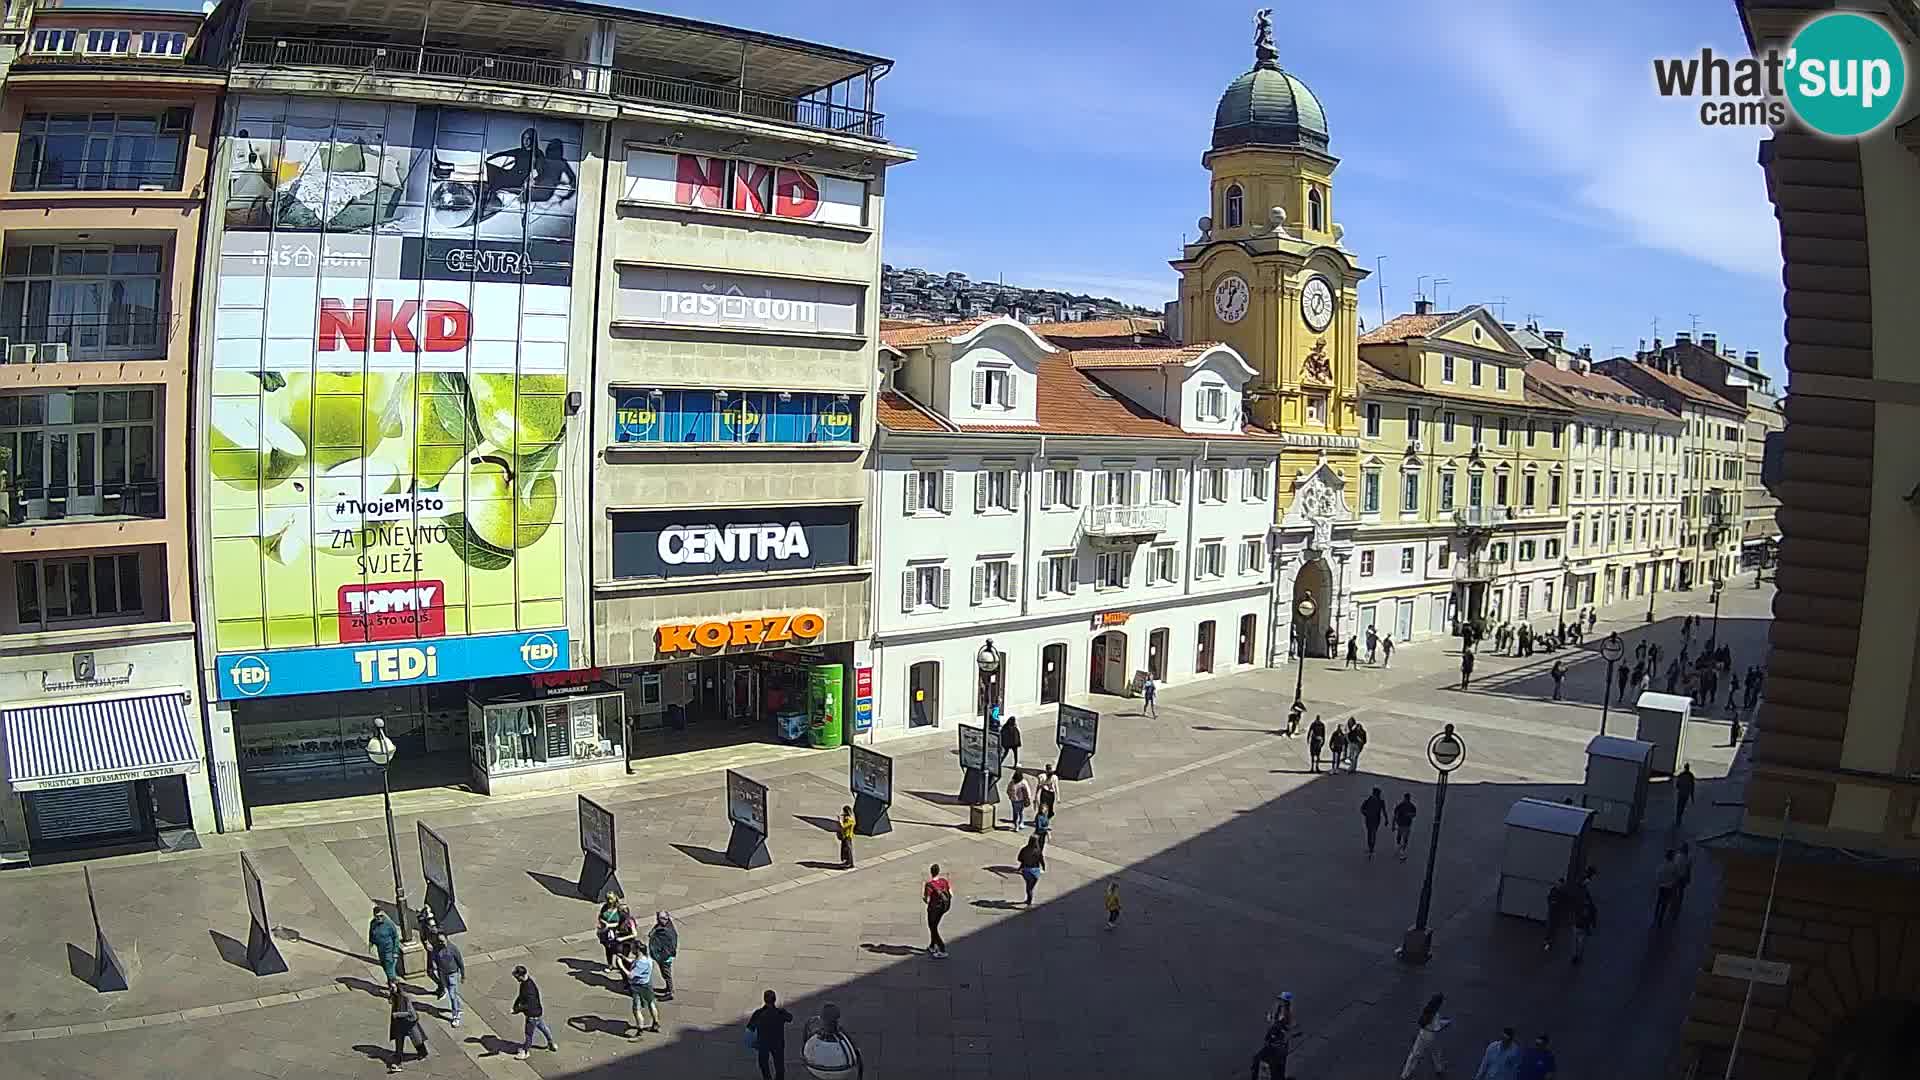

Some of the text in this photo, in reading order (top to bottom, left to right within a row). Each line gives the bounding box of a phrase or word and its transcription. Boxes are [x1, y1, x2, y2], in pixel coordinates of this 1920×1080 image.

[675, 153, 820, 218] NKD
[446, 249, 532, 274] CENTRA
[661, 282, 816, 322] naš dom
[318, 298, 474, 352] NKD
[336, 496, 443, 516] #TvojeMisto
[332, 524, 448, 549] ZA DNEVNO
[657, 520, 810, 565] CENTRA
[357, 547, 423, 575] SVJEŽE
[345, 586, 437, 615] TOMMY
[658, 613, 825, 653] KORZO
[354, 646, 440, 684] TEDi
[519, 642, 558, 661] TEDi
[230, 665, 270, 684] TEDi
[143, 767, 174, 779] CENTAR
